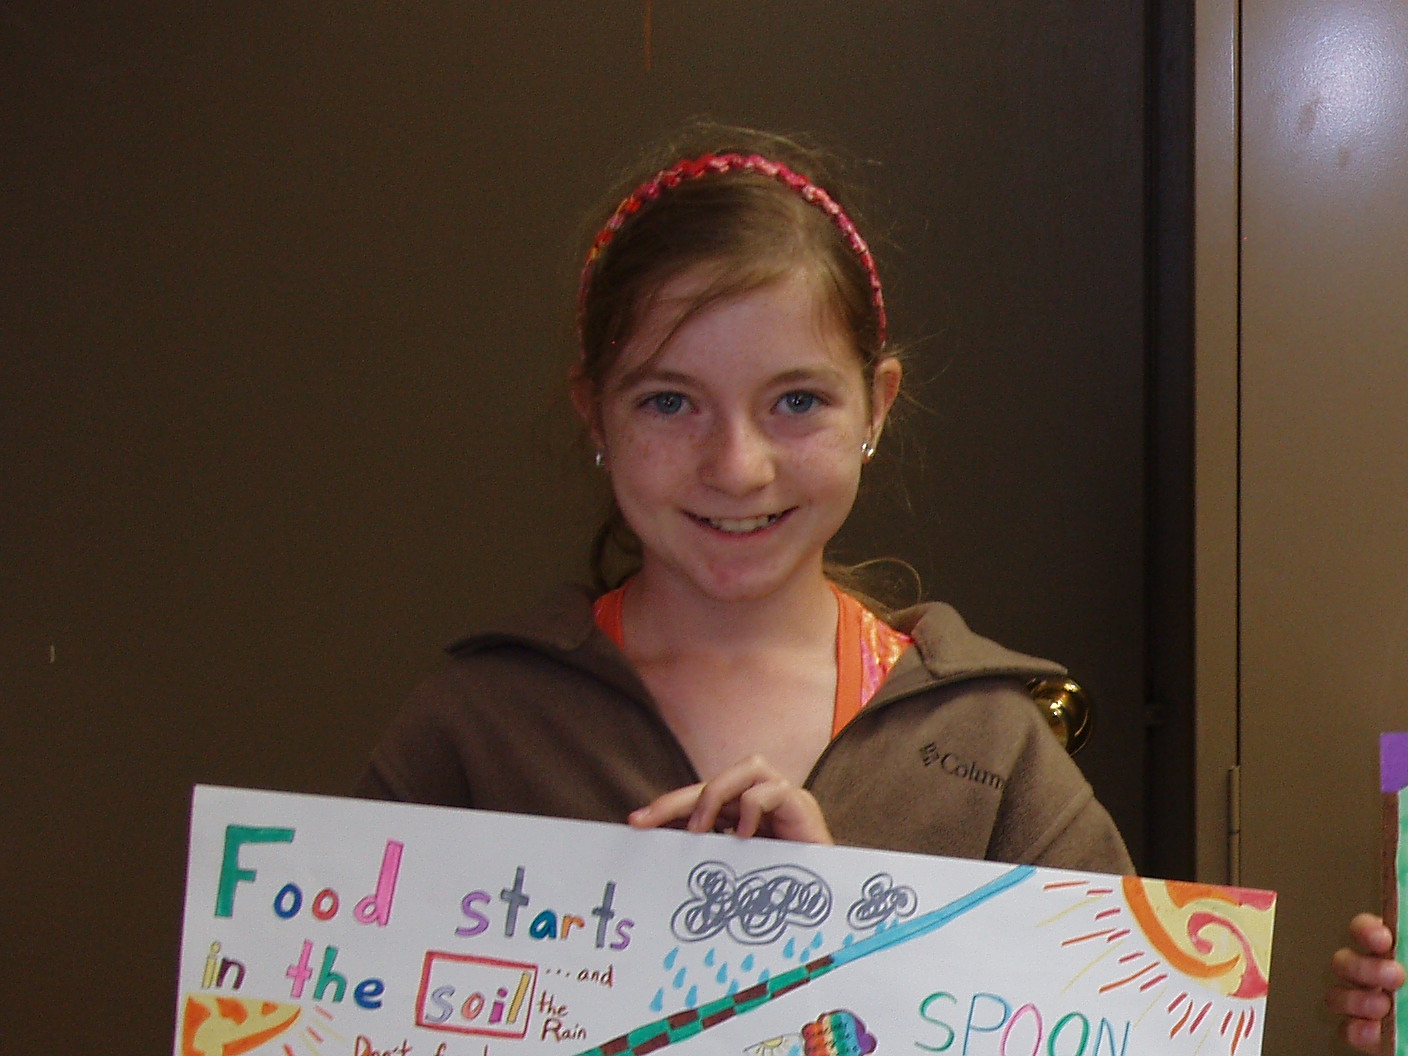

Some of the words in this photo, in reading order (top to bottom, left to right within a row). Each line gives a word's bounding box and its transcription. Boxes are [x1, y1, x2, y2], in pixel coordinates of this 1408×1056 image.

[214, 824, 404, 927] Food
[455, 866, 636, 951] starts
[201, 942, 246, 990] in
[286, 939, 385, 1009] the
[424, 971, 532, 1024] soil
[538, 990, 569, 1017] the
[541, 1019, 588, 1044] Rain
